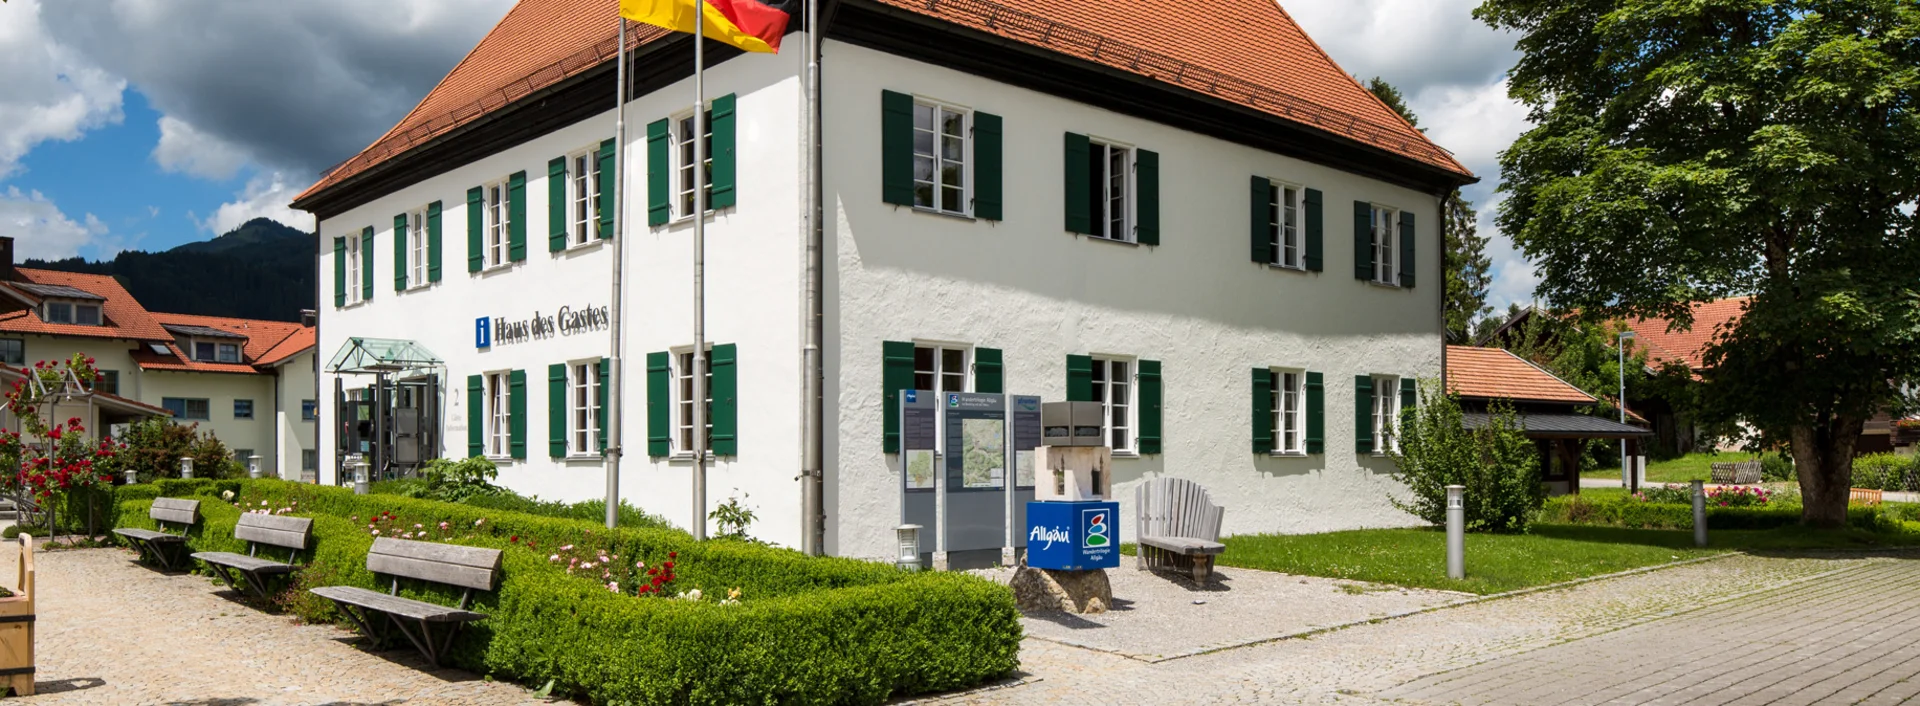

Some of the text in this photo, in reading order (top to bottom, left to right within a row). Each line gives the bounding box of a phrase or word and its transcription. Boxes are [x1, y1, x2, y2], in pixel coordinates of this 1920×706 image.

[494, 316, 528, 342] Haus
[531, 310, 554, 337] des
[557, 303, 608, 334] Gastes
[454, 387, 460, 406] 2
[1029, 525, 1070, 551] Allgäu
